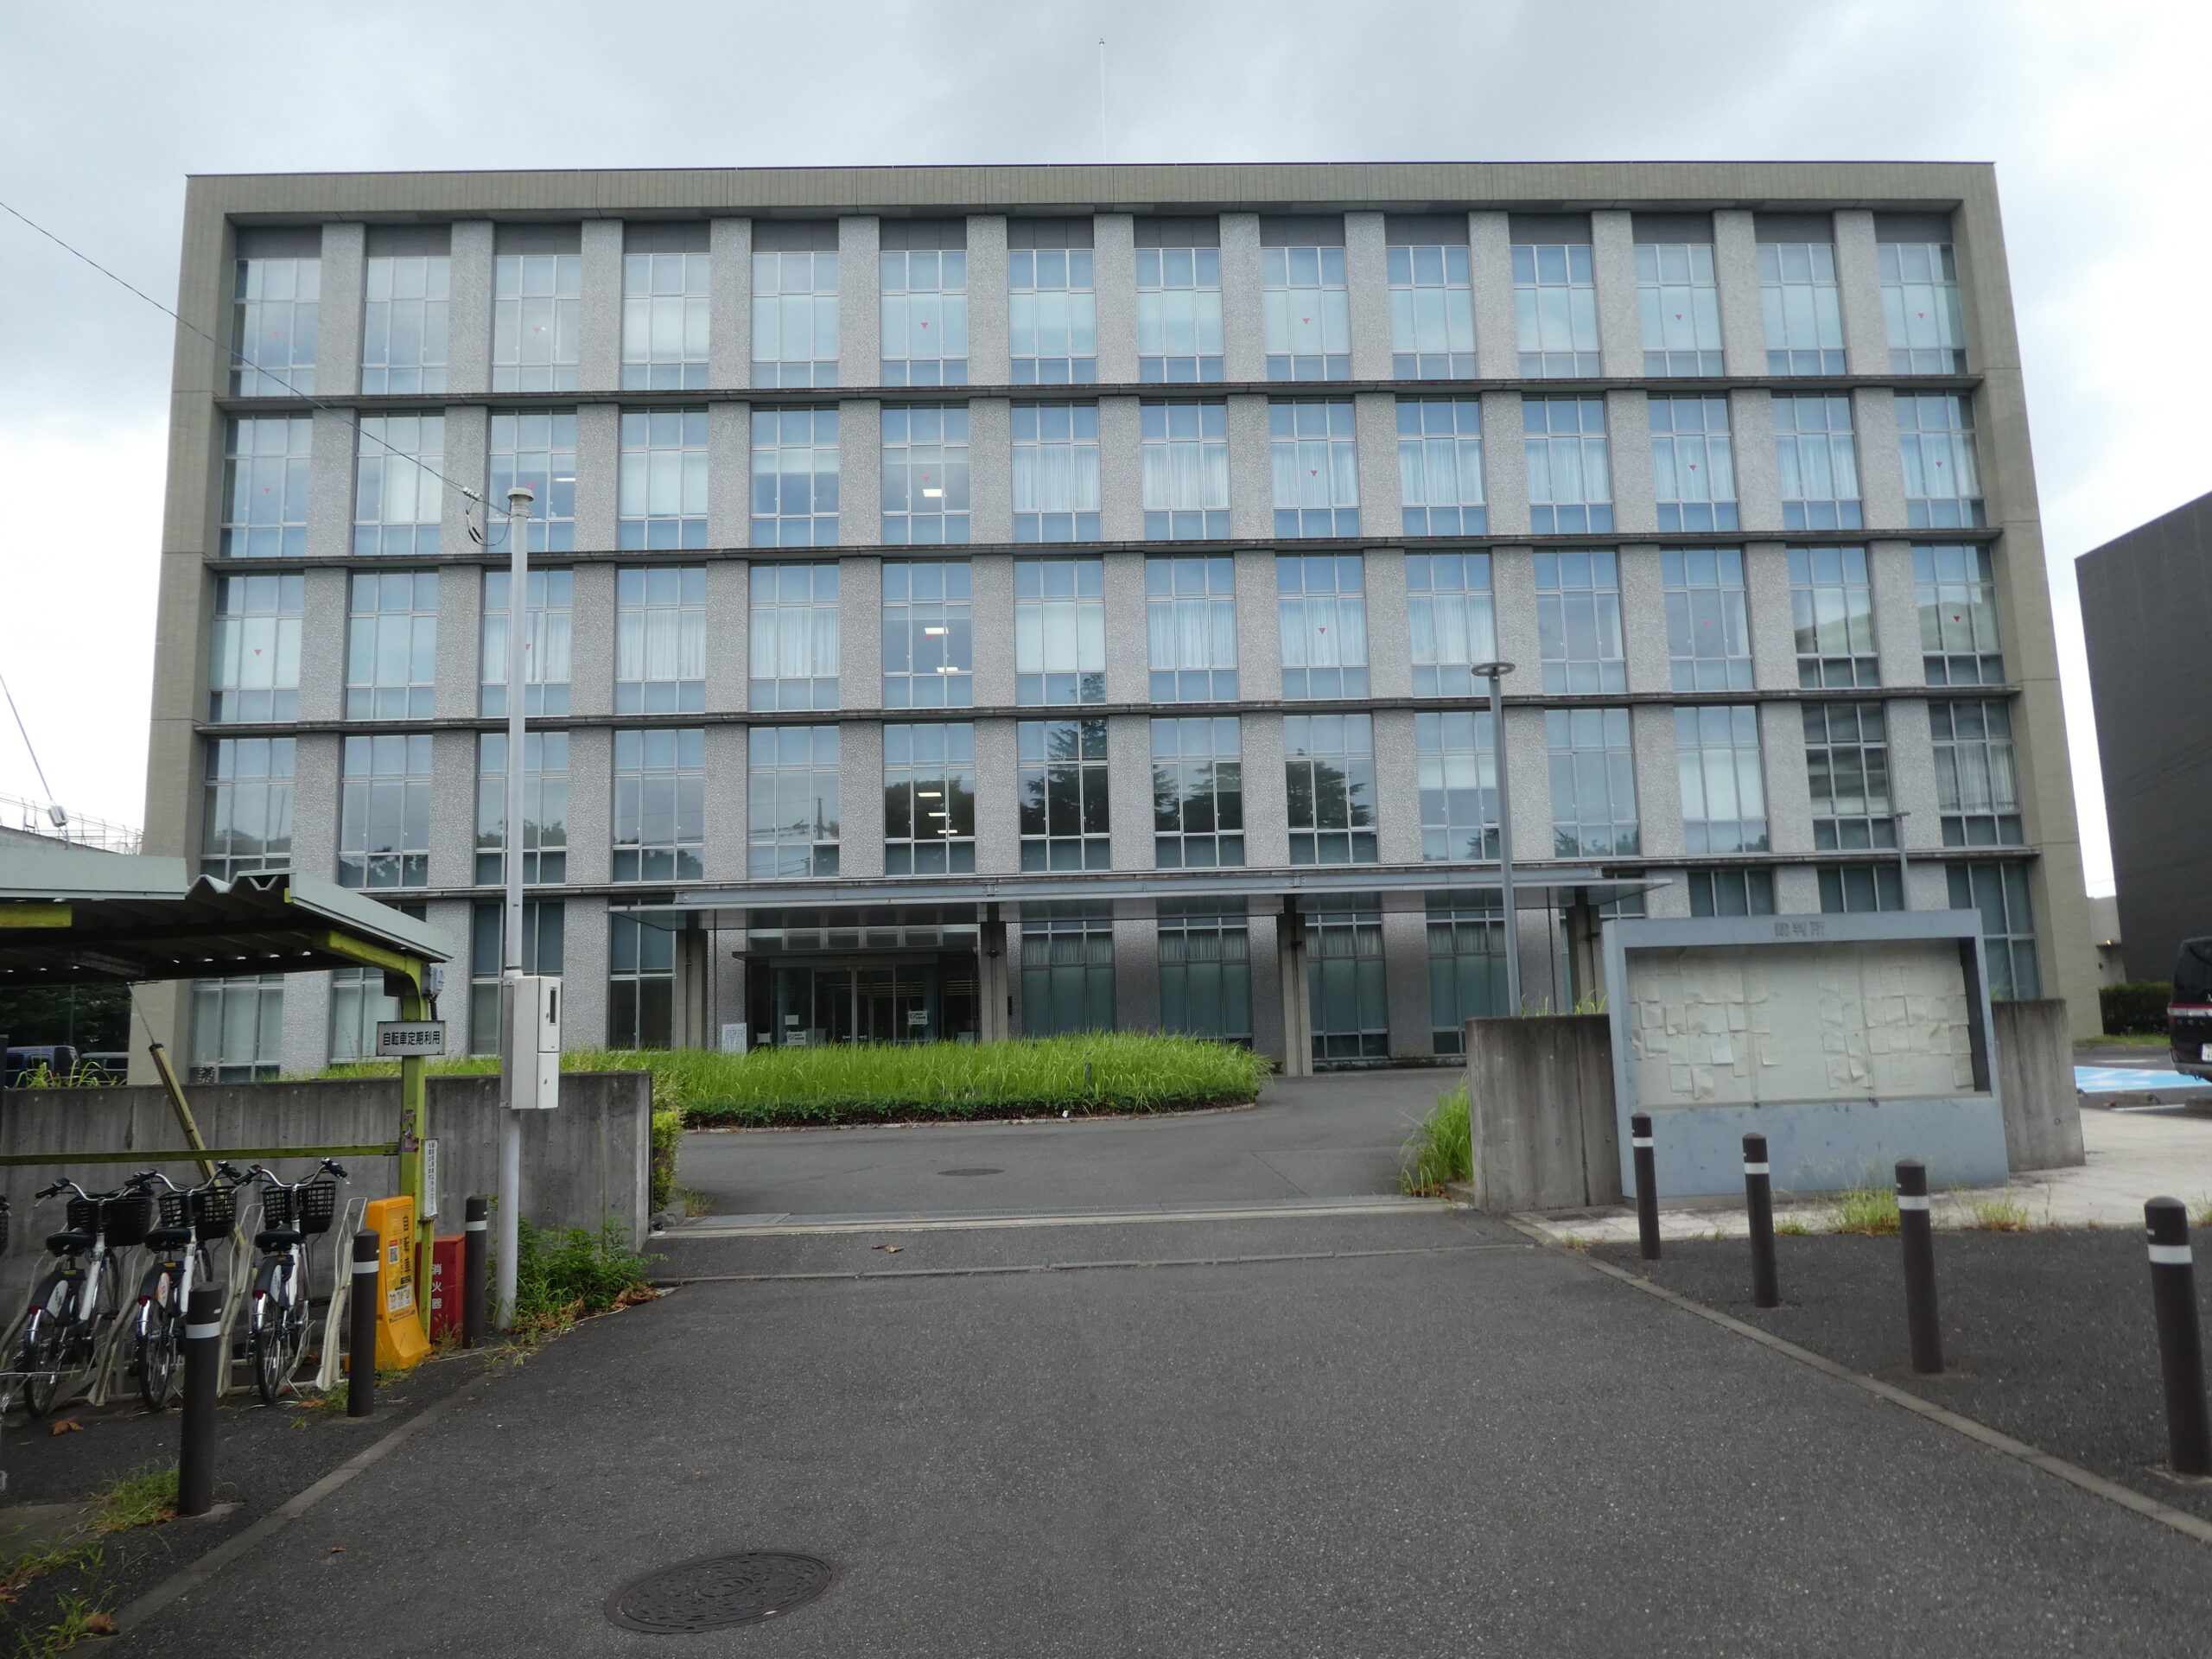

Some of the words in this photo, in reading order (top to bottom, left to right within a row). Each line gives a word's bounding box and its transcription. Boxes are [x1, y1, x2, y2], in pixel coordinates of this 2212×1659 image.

[383, 1031, 440, 1046] 自転車定期利用
[431, 1263, 442, 1309] 消火器
